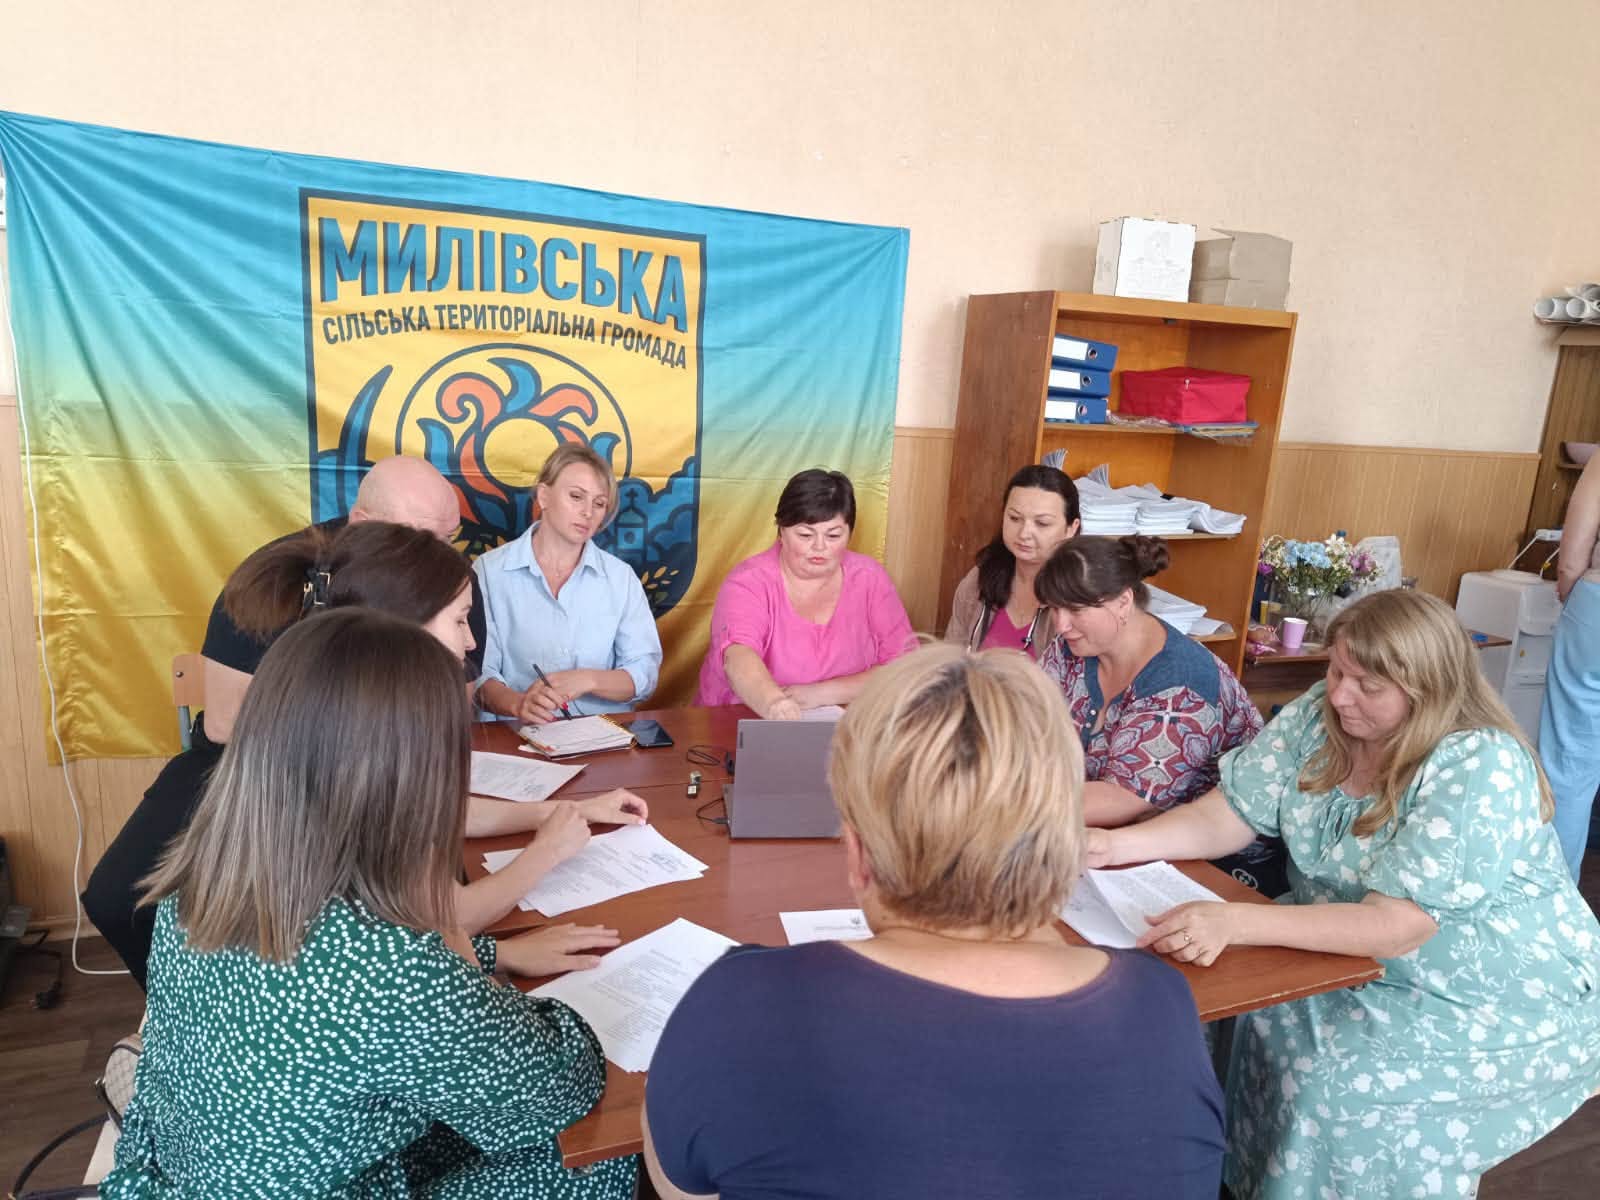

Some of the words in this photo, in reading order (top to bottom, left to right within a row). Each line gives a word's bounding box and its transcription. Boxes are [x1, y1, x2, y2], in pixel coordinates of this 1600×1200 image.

[318, 217, 688, 332] МИЛІВСЬКА
[323, 306, 431, 344] СІЛЬСЬКА
[434, 304, 595, 343] ТЕРИТОРІАЛЬНА
[601, 321, 687, 369] ГРОМАДА
